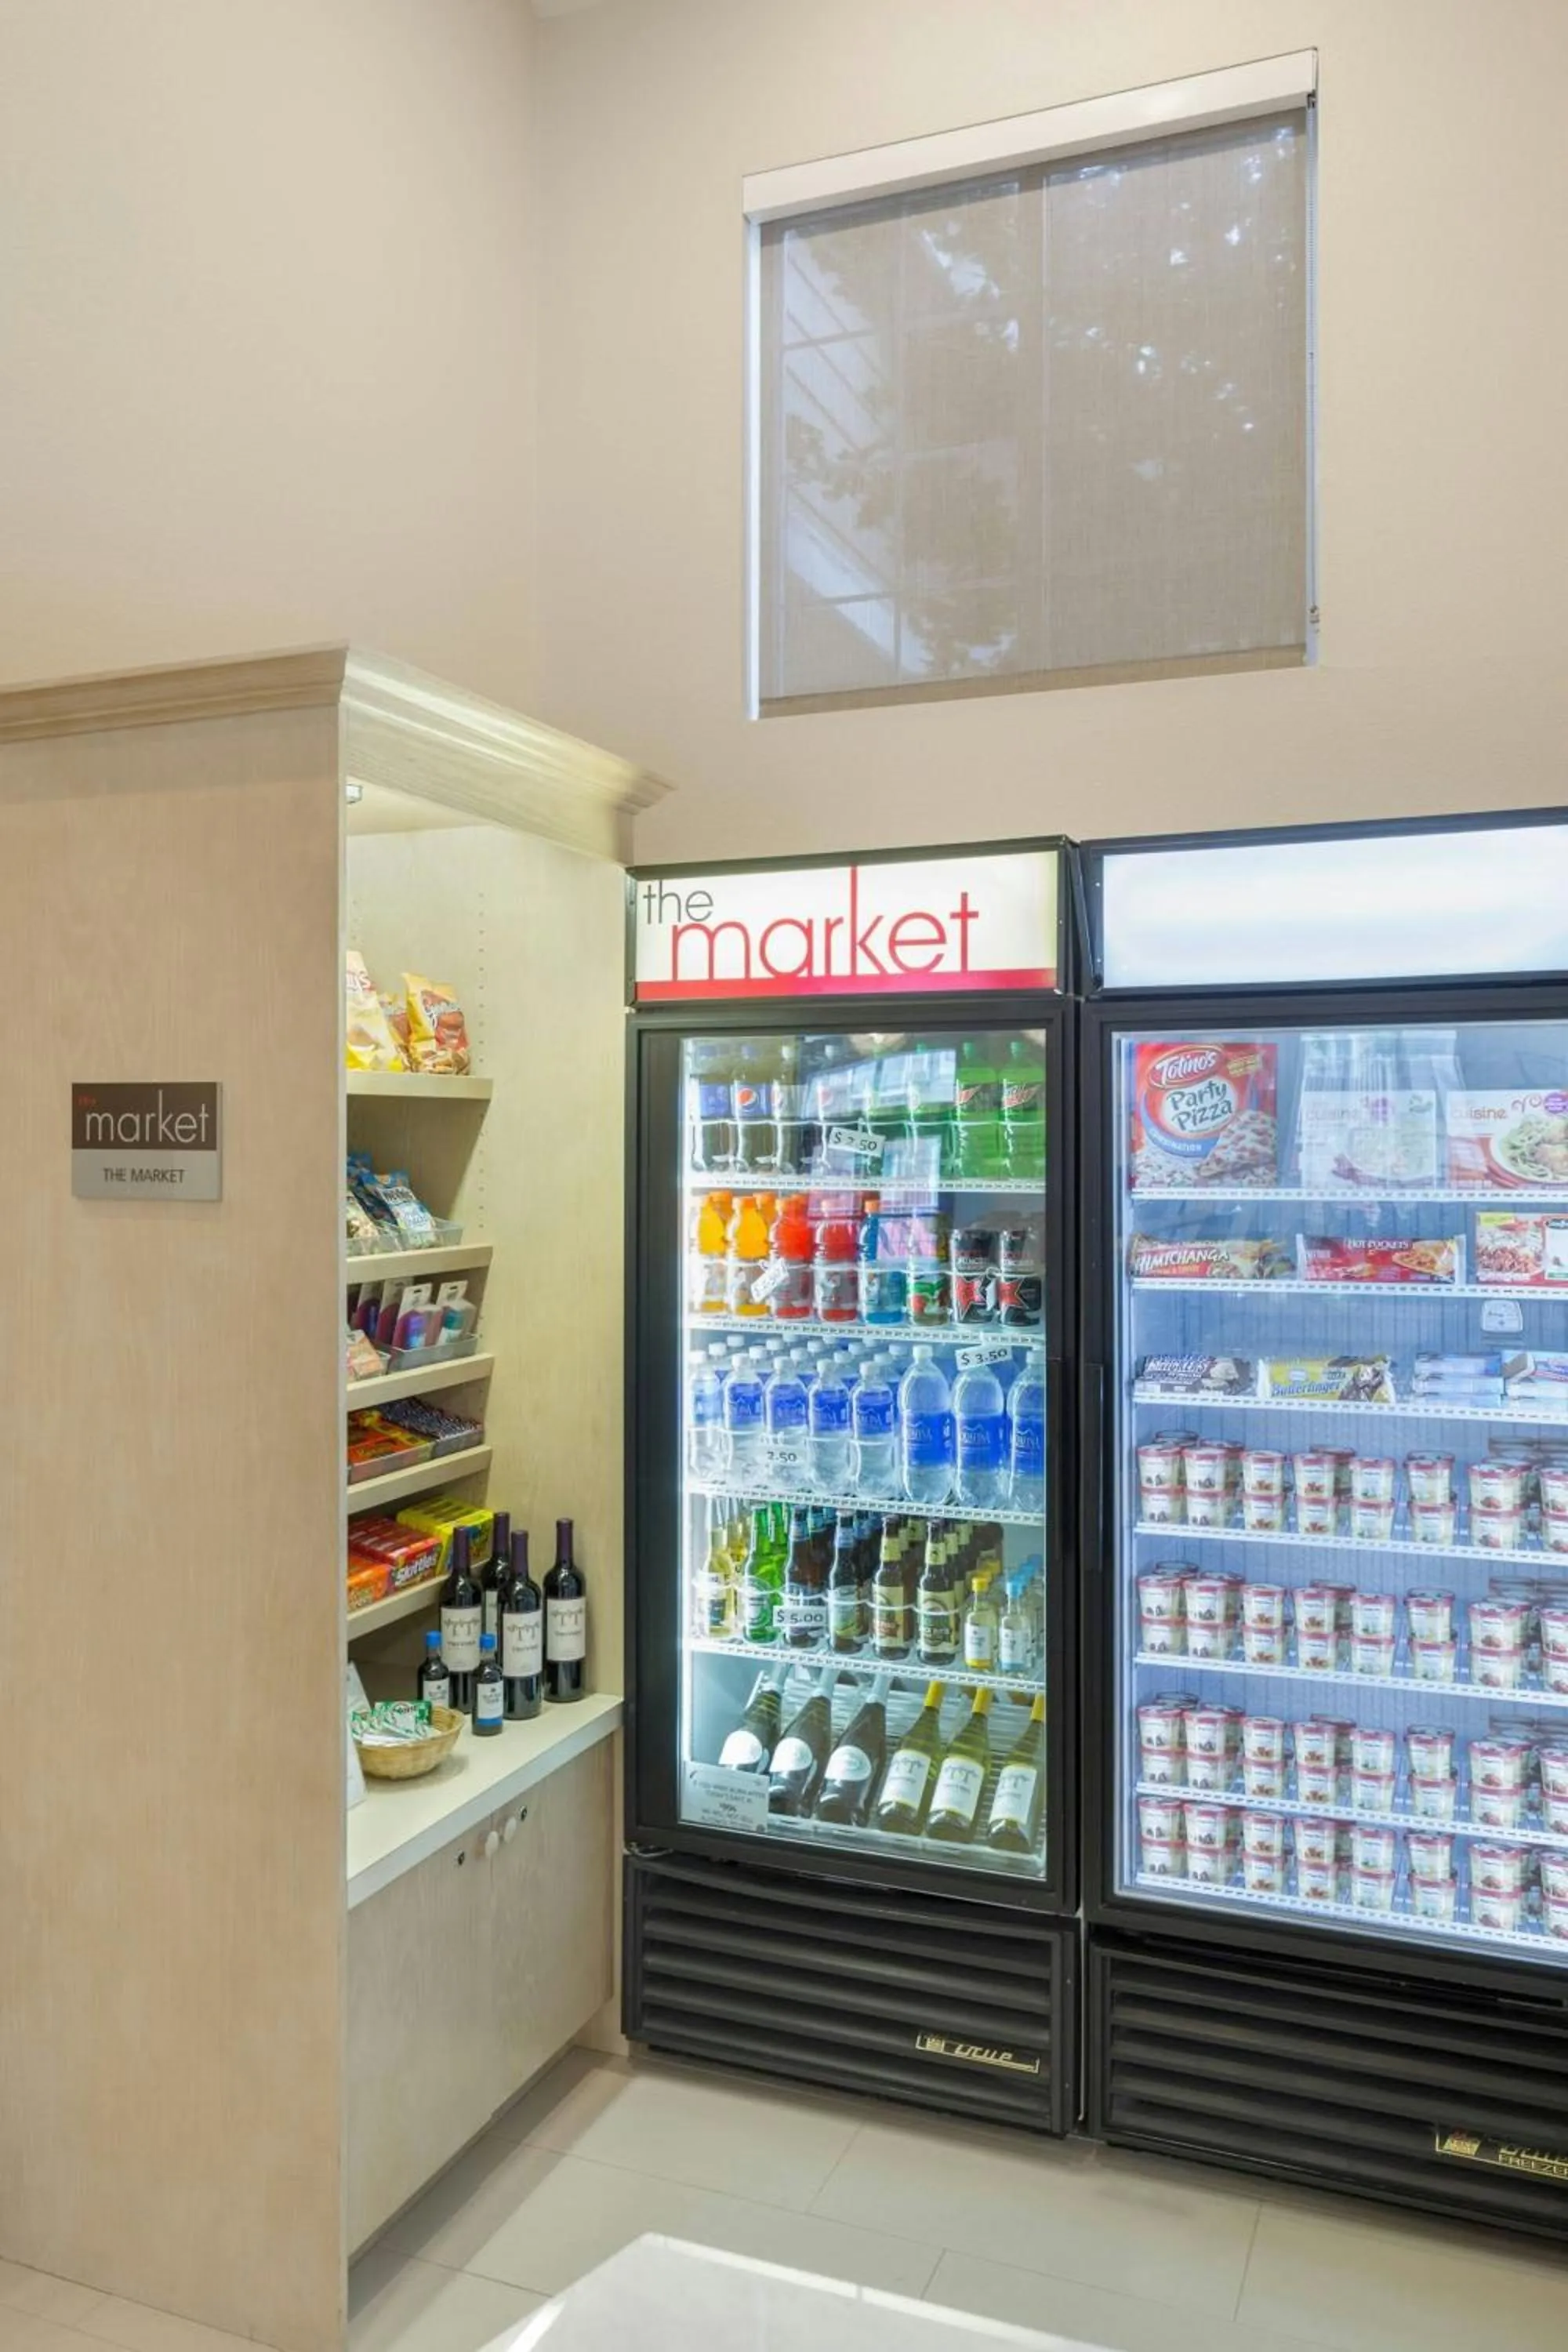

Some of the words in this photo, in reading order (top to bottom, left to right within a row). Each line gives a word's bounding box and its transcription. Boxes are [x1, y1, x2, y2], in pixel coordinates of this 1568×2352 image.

[642, 880, 714, 924] the
[671, 865, 979, 981] market
[1166, 1080, 1228, 1111] Party
[85, 1089, 209, 1143] market
[1171, 1098, 1232, 1131] Pizza
[103, 1167, 127, 1183] THE
[130, 1167, 186, 1184] MARKET
[960, 1351, 971, 1366] $
[975, 1348, 1008, 1365] 3.50
[777, 1609, 785, 1624] $
[789, 1613, 823, 1624] 5.00
